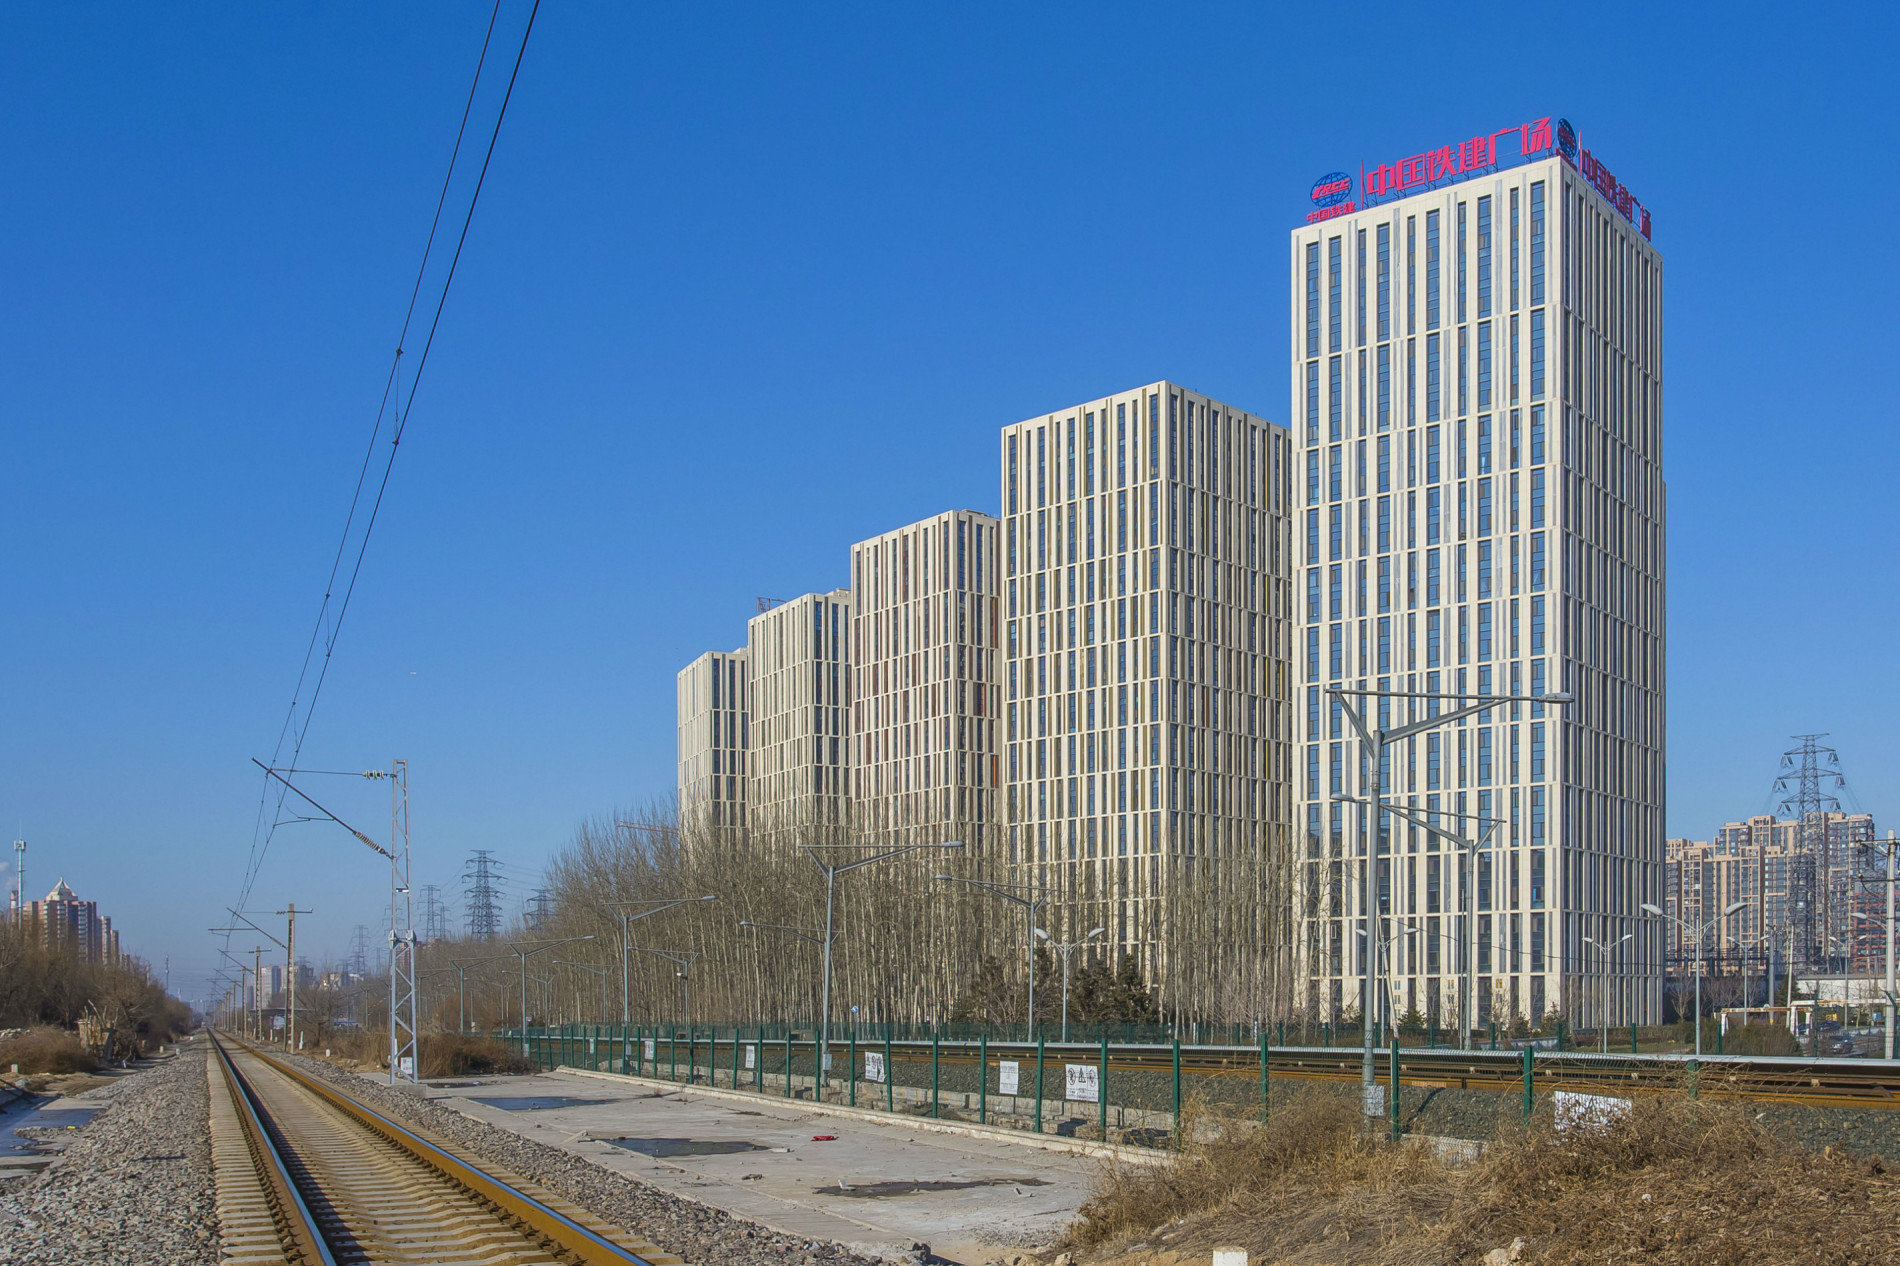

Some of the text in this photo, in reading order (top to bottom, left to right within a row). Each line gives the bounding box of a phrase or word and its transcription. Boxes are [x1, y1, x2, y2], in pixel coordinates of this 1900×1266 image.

[1367, 116, 1551, 196] 中国铁建广场
[1306, 200, 1356, 224] 中国铁建
